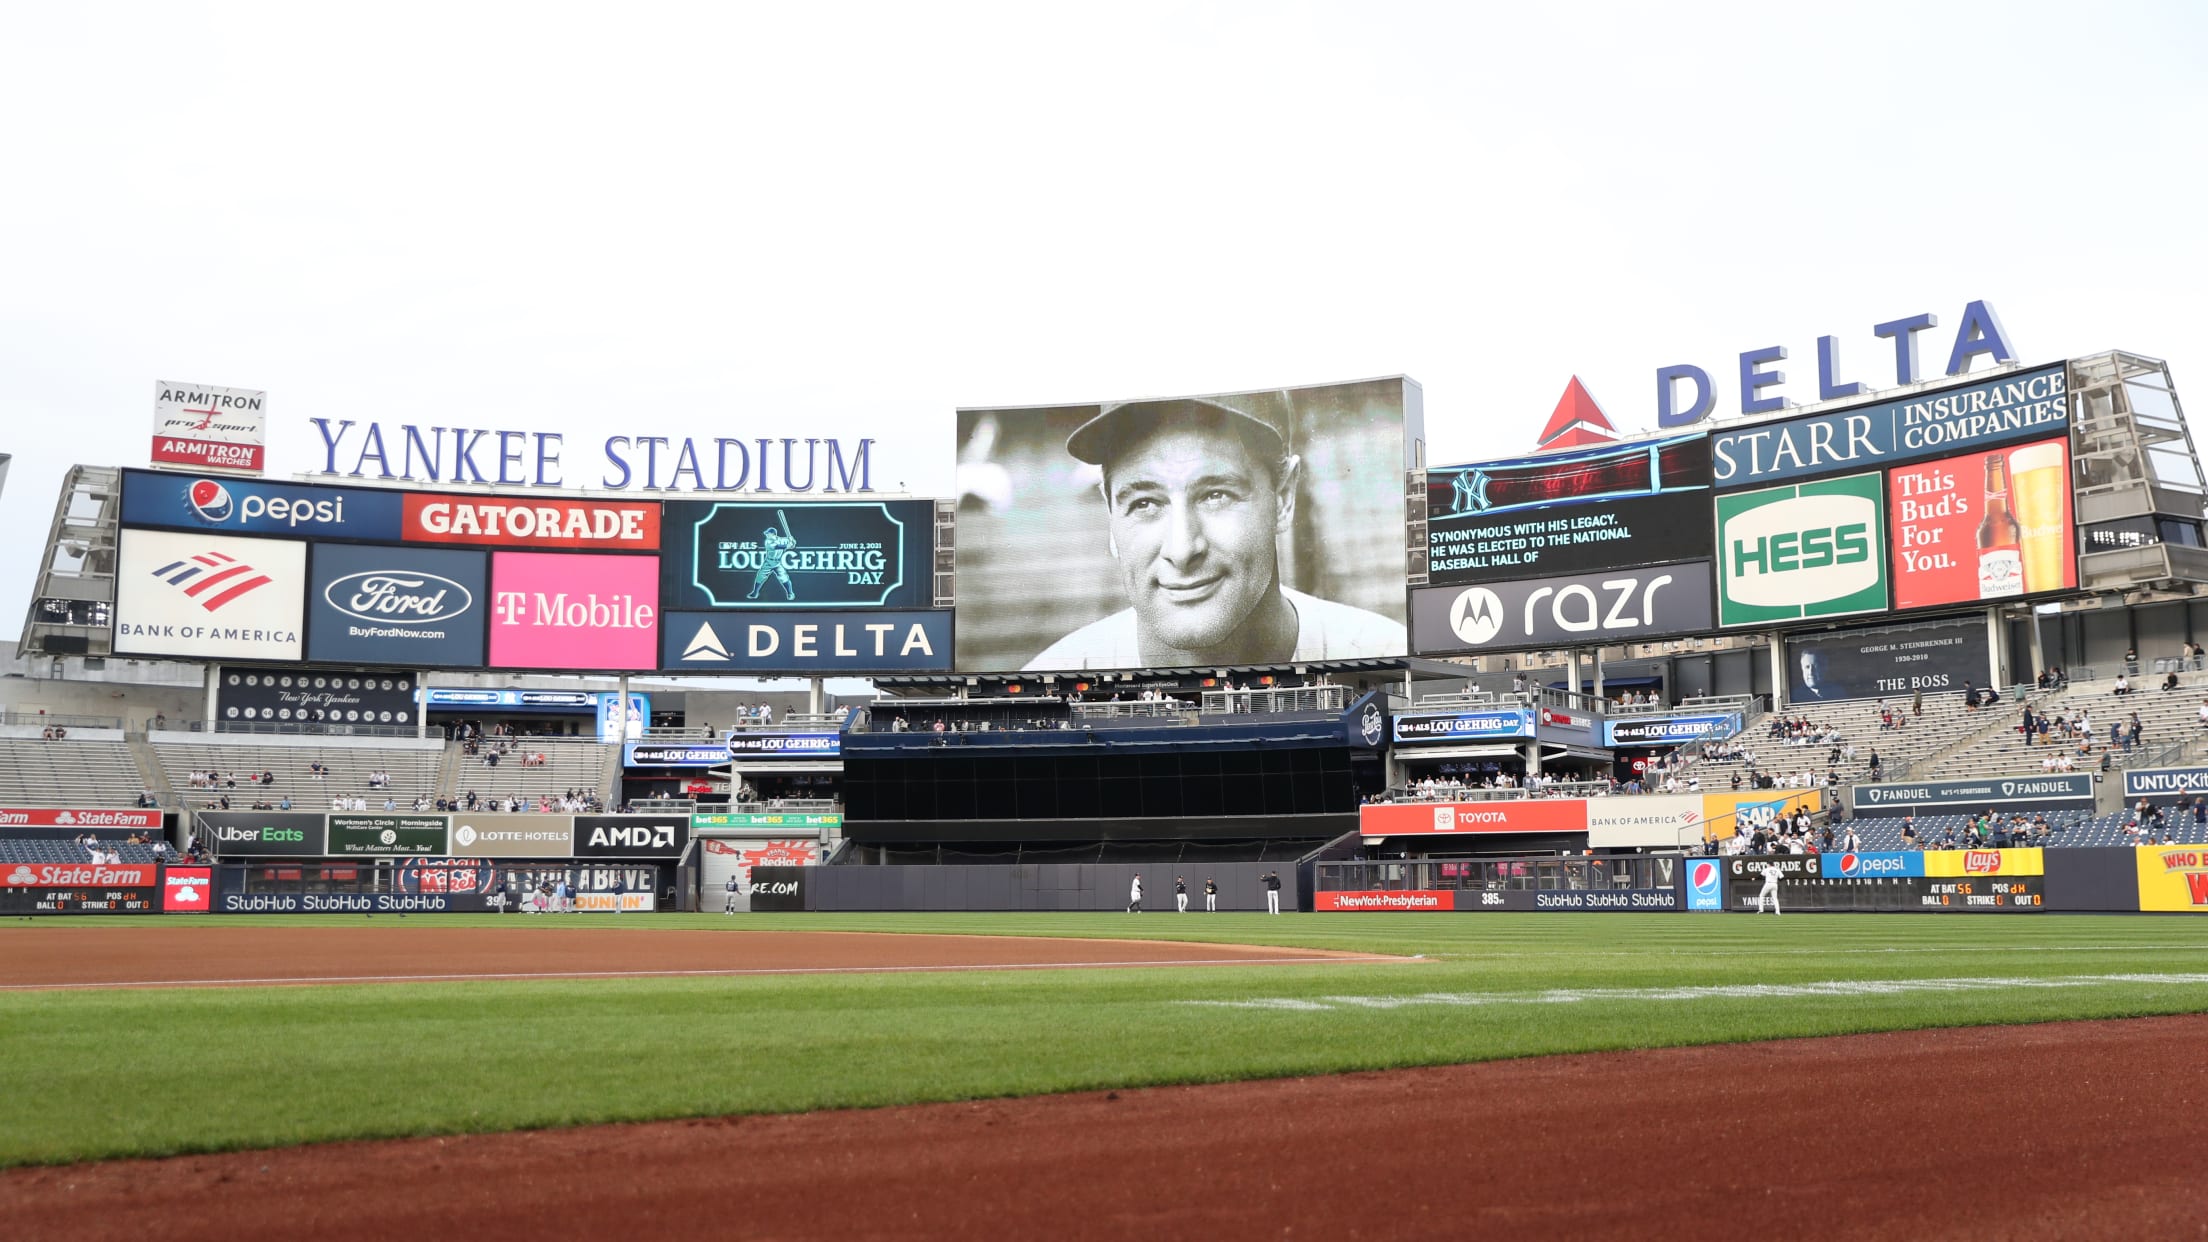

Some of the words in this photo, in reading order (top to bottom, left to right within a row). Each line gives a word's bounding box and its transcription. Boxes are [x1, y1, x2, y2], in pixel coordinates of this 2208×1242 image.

[1657, 300, 2020, 427] DELTA
[160, 389, 261, 410] ARMITRON
[1904, 371, 2066, 426] INSURANCE
[165, 419, 196, 427] pro
[212, 423, 257, 432] sport
[1904, 397, 2067, 449] COMPANIES
[162, 440, 255, 459] ARMITRON
[310, 417, 563, 487] YANKEE
[602, 435, 876, 492] STADIUM
[1714, 414, 1884, 480] STARR
[207, 455, 251, 466] WATCHES
[1898, 469, 1955, 497] This
[241, 495, 344, 527] pepsi
[1900, 493, 1968, 522] Bud's
[421, 502, 645, 540] GATORADE
[1430, 525, 1512, 544] SYNONYMOUS
[1514, 522, 1545, 535] WITH
[1548, 520, 1568, 532] HIS
[1571, 513, 1618, 530] LEGACY.
[1430, 546, 1446, 557] HE
[1452, 543, 1475, 555] WAS
[1478, 538, 1526, 552] ELECTED
[1530, 536, 1545, 548] TO
[1549, 533, 1570, 547] THE
[1573, 527, 1631, 543] NATIONAL
[1901, 526, 1943, 548] For
[740, 542, 757, 550] ALS
[1734, 522, 1868, 577] HESS
[718, 551, 765, 569] LOU
[781, 551, 886, 570] GEHRIG
[1431, 558, 1488, 572] BASEBALL
[1492, 552, 1521, 567] HALL
[1524, 551, 1539, 563] OF
[1902, 549, 1957, 573] You.
[848, 572, 885, 585] DAY
[353, 576, 447, 617] Ford
[532, 592, 654, 629] Mobile
[1525, 574, 1672, 635] razr
[121, 623, 173, 638] BANK
[180, 626, 204, 639] OF
[211, 626, 297, 643] AMERICA
[349, 626, 445, 639] BuyFordNow.com
[748, 623, 935, 657] DELTA
[1861, 645, 1888, 653] GEORGE
[1899, 639, 1952, 651] STEINBRENNER
[1895, 653, 1928, 662] 1930-2010
[1877, 677, 1905, 691] THE
[1911, 673, 1949, 689] BOSS
[1430, 720, 1453, 732] LOU
[1456, 718, 1502, 731] GEHRIG
[1503, 719, 1519, 727] DAY
[1631, 728, 1644, 736] ALS
[1645, 725, 1666, 736] LOU
[1669, 723, 1713, 735] GEHRIG
[762, 738, 784, 749] LOU
[786, 739, 830, 749] GEHRIG
[664, 750, 684, 760] LOU
[686, 750, 728, 760] GEHRIG
[2133, 772, 2208, 790] UNTUCKit
[1883, 788, 1931, 801] FANDUEL
[2017, 780, 2073, 794] FANDUEL
[77, 811, 147, 825] StateFarm
[696, 816, 728, 824] bet365
[751, 816, 783, 824] bet365
[806, 815, 838, 824] bet365
[1458, 812, 1507, 824] TOYOTA
[1592, 817, 1615, 826] BANK
[1618, 817, 1631, 825] OF
[1633, 816, 1677, 825] AMERICA
[219, 827, 259, 841] Uber
[262, 827, 304, 842] Eats
[481, 831, 522, 841] LOTTE
[525, 831, 569, 841] HOTELS
[588, 827, 651, 847] AMD
[760, 858, 797, 867] RedHot
[1732, 860, 1743, 875] G
[1747, 861, 1801, 872] GATRADE
[1805, 858, 1817, 873] G
[1862, 855, 1905, 874] pepsi
[2163, 852, 2198, 869] WHO
[40, 866, 141, 885] StateFarm
[167, 876, 209, 885] StateFarm
[1931, 884, 1940, 893] AT
[1941, 884, 1956, 893] BAT
[1992, 883, 2009, 893] POS
[107, 892, 122, 900] POS
[226, 896, 296, 911] StubHub
[303, 896, 372, 911] StubHub
[378, 895, 446, 910] StubHub
[575, 896, 645, 909] DUNIN'
[1340, 893, 1438, 909] NewYork-Presbyterian
[1481, 893, 1499, 905] 385
[1537, 894, 1582, 907] StubHub
[1586, 893, 1628, 907] StubHub
[1632, 893, 1675, 907] StubHub
[1696, 897, 1717, 907] pepsi
[1922, 895, 1941, 905] BALL
[1942, 895, 1949, 905] 0
[1967, 895, 1995, 905] STRIKE
[1996, 895, 2003, 905] 0
[2015, 895, 2032, 905] OUT
[2033, 895, 2041, 905] 0
[37, 901, 56, 910] BALL
[58, 901, 63, 910] 0
[82, 901, 108, 909] STRIKE
[110, 901, 115, 909] 0
[126, 901, 141, 909] OUT
[143, 901, 149, 909] 0
